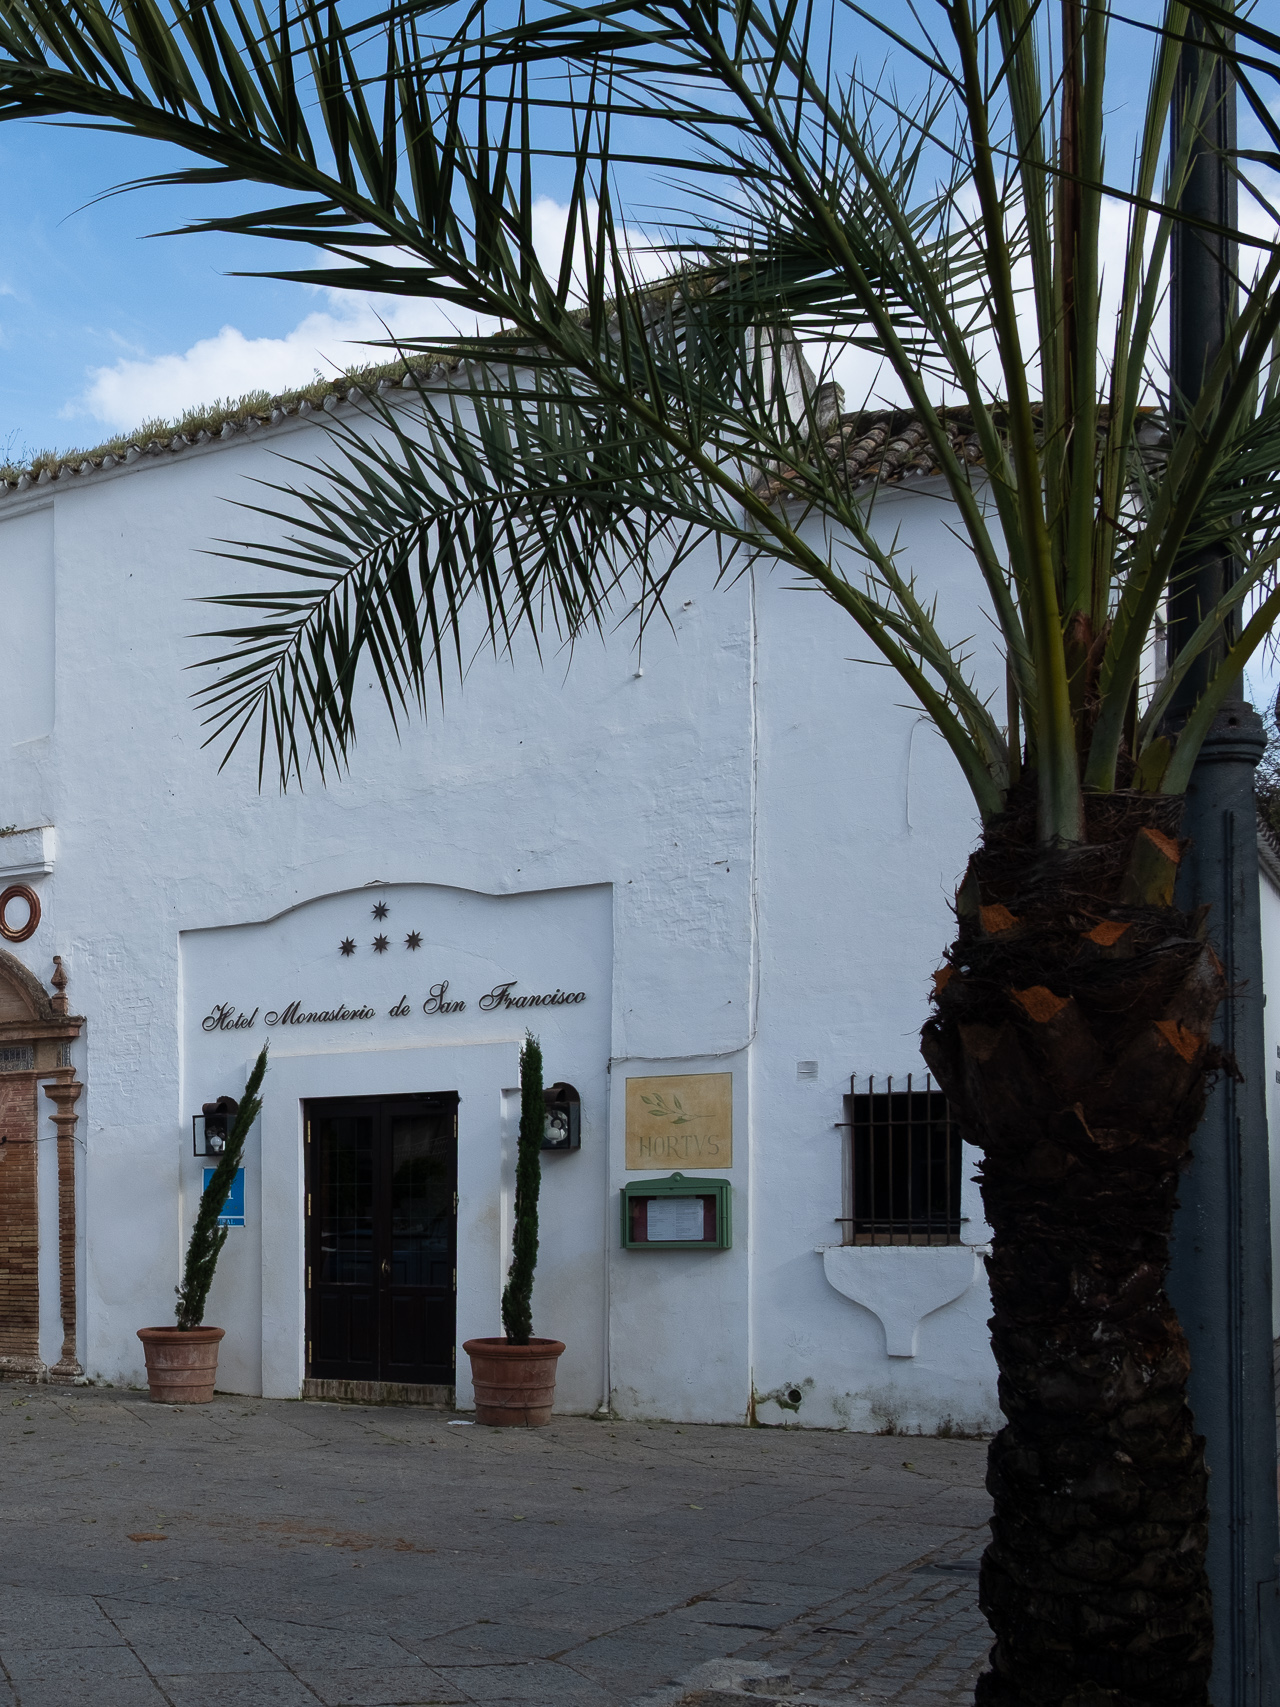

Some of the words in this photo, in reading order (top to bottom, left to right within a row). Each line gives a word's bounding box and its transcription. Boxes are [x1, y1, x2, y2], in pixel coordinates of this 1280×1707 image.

[201, 1001, 259, 1032] Hotel
[263, 1000, 376, 1027] Monasterio
[388, 994, 411, 1017] de
[422, 979, 466, 1015] San
[478, 980, 587, 1011] Francisco
[638, 1134, 720, 1160] HORTVS
